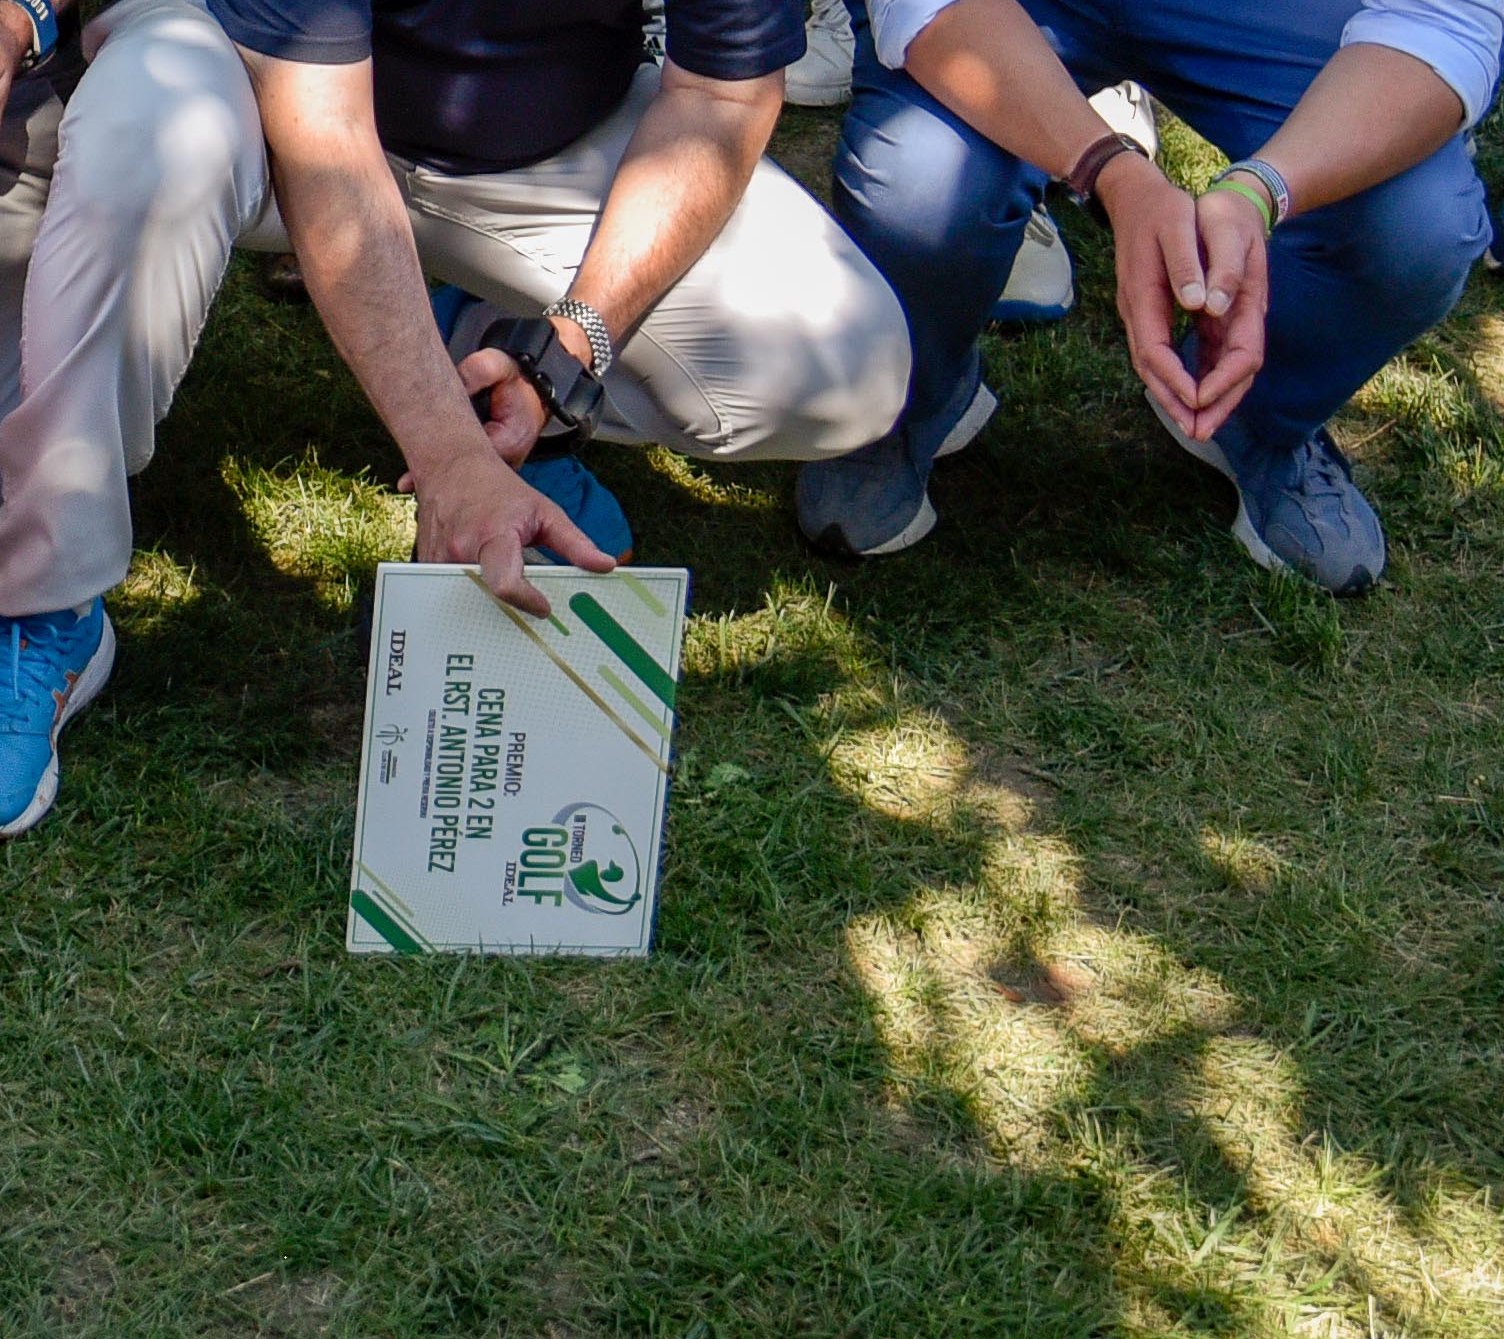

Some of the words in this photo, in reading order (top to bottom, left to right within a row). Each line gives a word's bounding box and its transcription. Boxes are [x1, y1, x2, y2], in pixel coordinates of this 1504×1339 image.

[386, 629, 405, 695] IDEAL
[446, 654, 474, 676] EL
[442, 681, 471, 719] RST.
[475, 688, 505, 738] CENA
[434, 724, 467, 809] ANTONIO
[469, 744, 500, 793] PARA
[503, 732, 526, 797] PREMIO:
[465, 815, 493, 839] EN
[468, 798, 495, 809] 2
[428, 814, 462, 872] PÉREZ
[517, 827, 569, 907] GOLF
[502, 861, 516, 906] IDEAL
